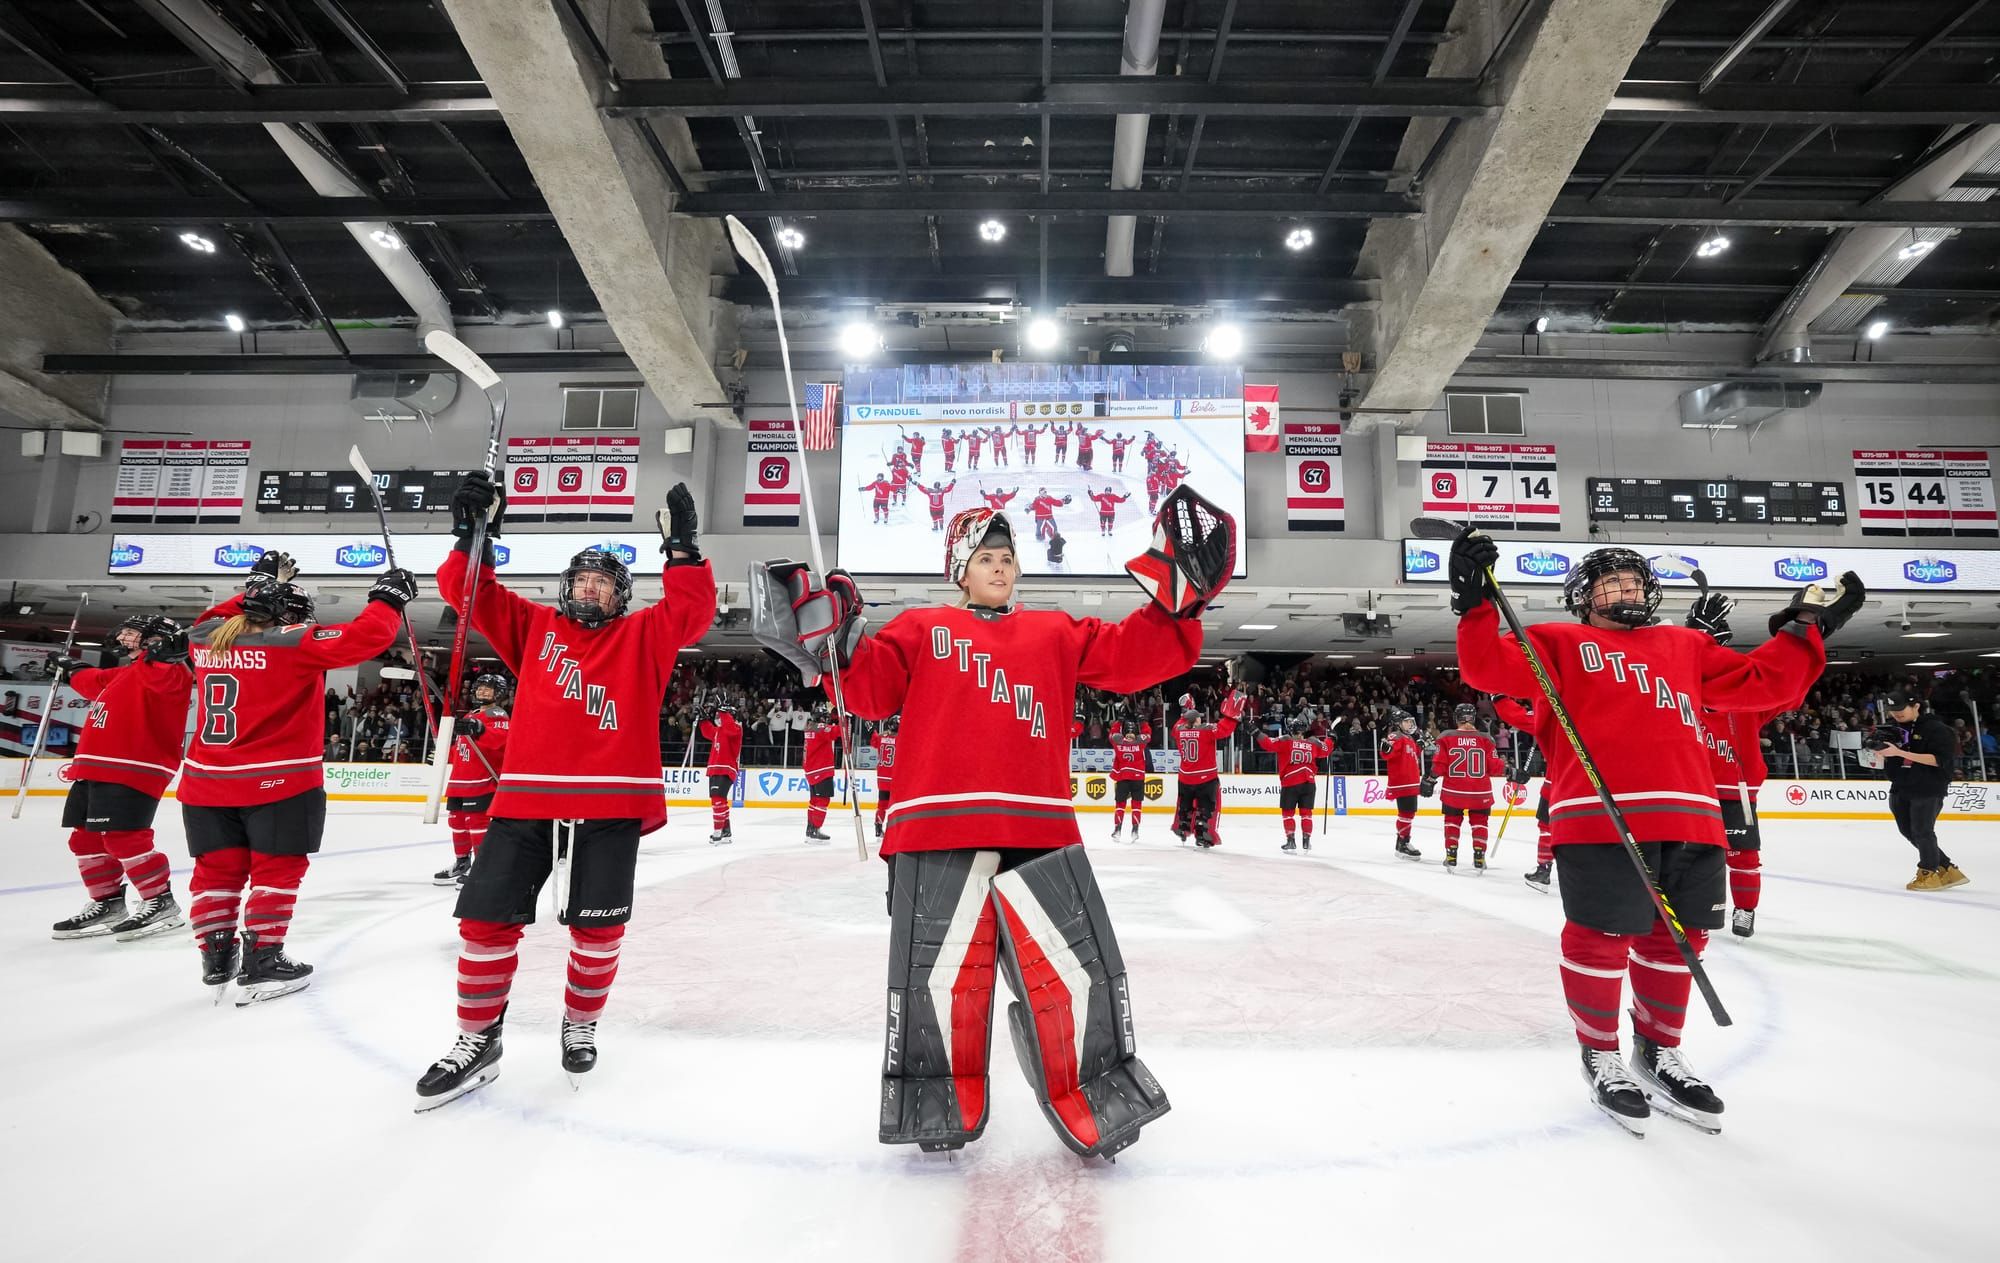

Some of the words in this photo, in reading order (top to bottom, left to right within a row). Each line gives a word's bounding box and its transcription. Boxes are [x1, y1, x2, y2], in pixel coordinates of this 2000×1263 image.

[873, 408, 922, 416] FANDUEL
[969, 406, 1006, 415] nordisk
[751, 443, 798, 451] CHAMPIONS
[1288, 446, 1338, 454] CHAMPIONS
[519, 473, 534, 485] 67
[562, 473, 578, 484] 67
[606, 473, 622, 484] 67
[764, 465, 784, 479] 67
[1304, 468, 1324, 484] 67
[1436, 479, 1451, 491] 67
[1482, 476, 1498, 497] 7
[1520, 477, 1551, 499] 14
[263, 487, 279, 499] 22
[1598, 495, 1612, 506] 22
[1865, 482, 1895, 504] 15
[1907, 482, 1945, 504] 44
[345, 494, 355, 509] 5
[412, 494, 423, 509] 3
[1827, 499, 1838, 510] 18
[1685, 503, 1695, 519] 5
[1715, 506, 1723, 518] 3
[1757, 504, 1766, 520] 3
[112, 551, 140, 566] yale
[217, 549, 262, 566] Royale
[339, 549, 383, 566] Royale
[1406, 555, 1436, 570] yale
[1521, 556, 1567, 574] Royale
[1778, 561, 1824, 580] Royale
[1907, 563, 1953, 582] Royale
[757, 573, 767, 623] TRUE
[931, 625, 1047, 739] OTTAWA
[200, 673, 240, 746] 8
[1457, 737, 1477, 747] DAVIS
[1180, 738, 1199, 763] 30
[1448, 747, 1487, 779] 20
[326, 767, 391, 780] Schneider
[664, 770, 701, 784] LETIC
[352, 779, 389, 788] Electric
[1087, 783, 1106, 798] ups
[1144, 783, 1163, 798] ups
[1810, 790, 1838, 801] AIR
[1839, 789, 1888, 801] CANAD
[1947, 783, 1988, 800] ockey
[578, 906, 629, 917] BAUER
[1115, 977, 1135, 1054] TRUE
[887, 991, 901, 1073] TRUE
